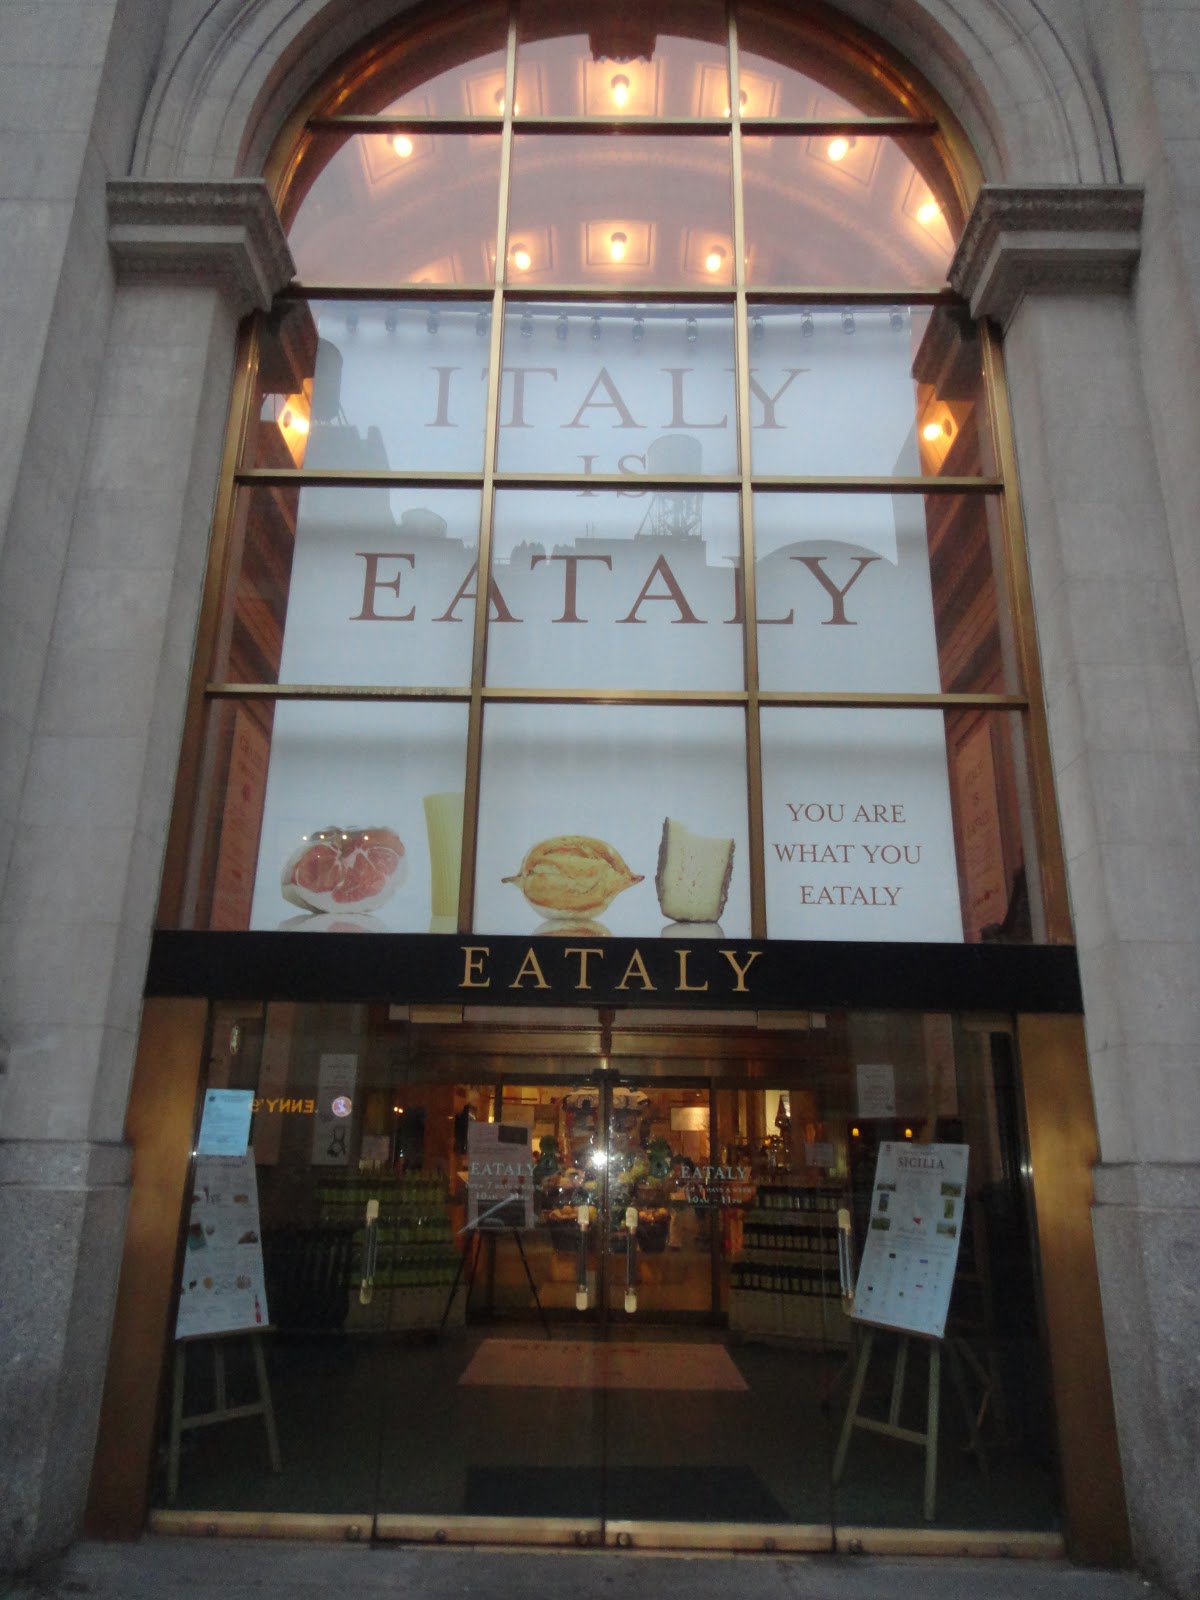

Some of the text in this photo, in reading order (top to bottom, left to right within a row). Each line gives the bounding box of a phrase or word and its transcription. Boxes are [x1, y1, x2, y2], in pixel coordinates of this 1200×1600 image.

[423, 366, 811, 430] ITALY
[576, 454, 648, 498] IS
[349, 552, 882, 625] EATALY
[786, 803, 906, 823] YOU ARE
[772, 843, 922, 865] WHAT YOU
[799, 885, 903, 906] EATALY
[457, 946, 763, 992] EATALY
[471, 1162, 538, 1177] EATALY
[680, 1165, 751, 1180] EATALY
